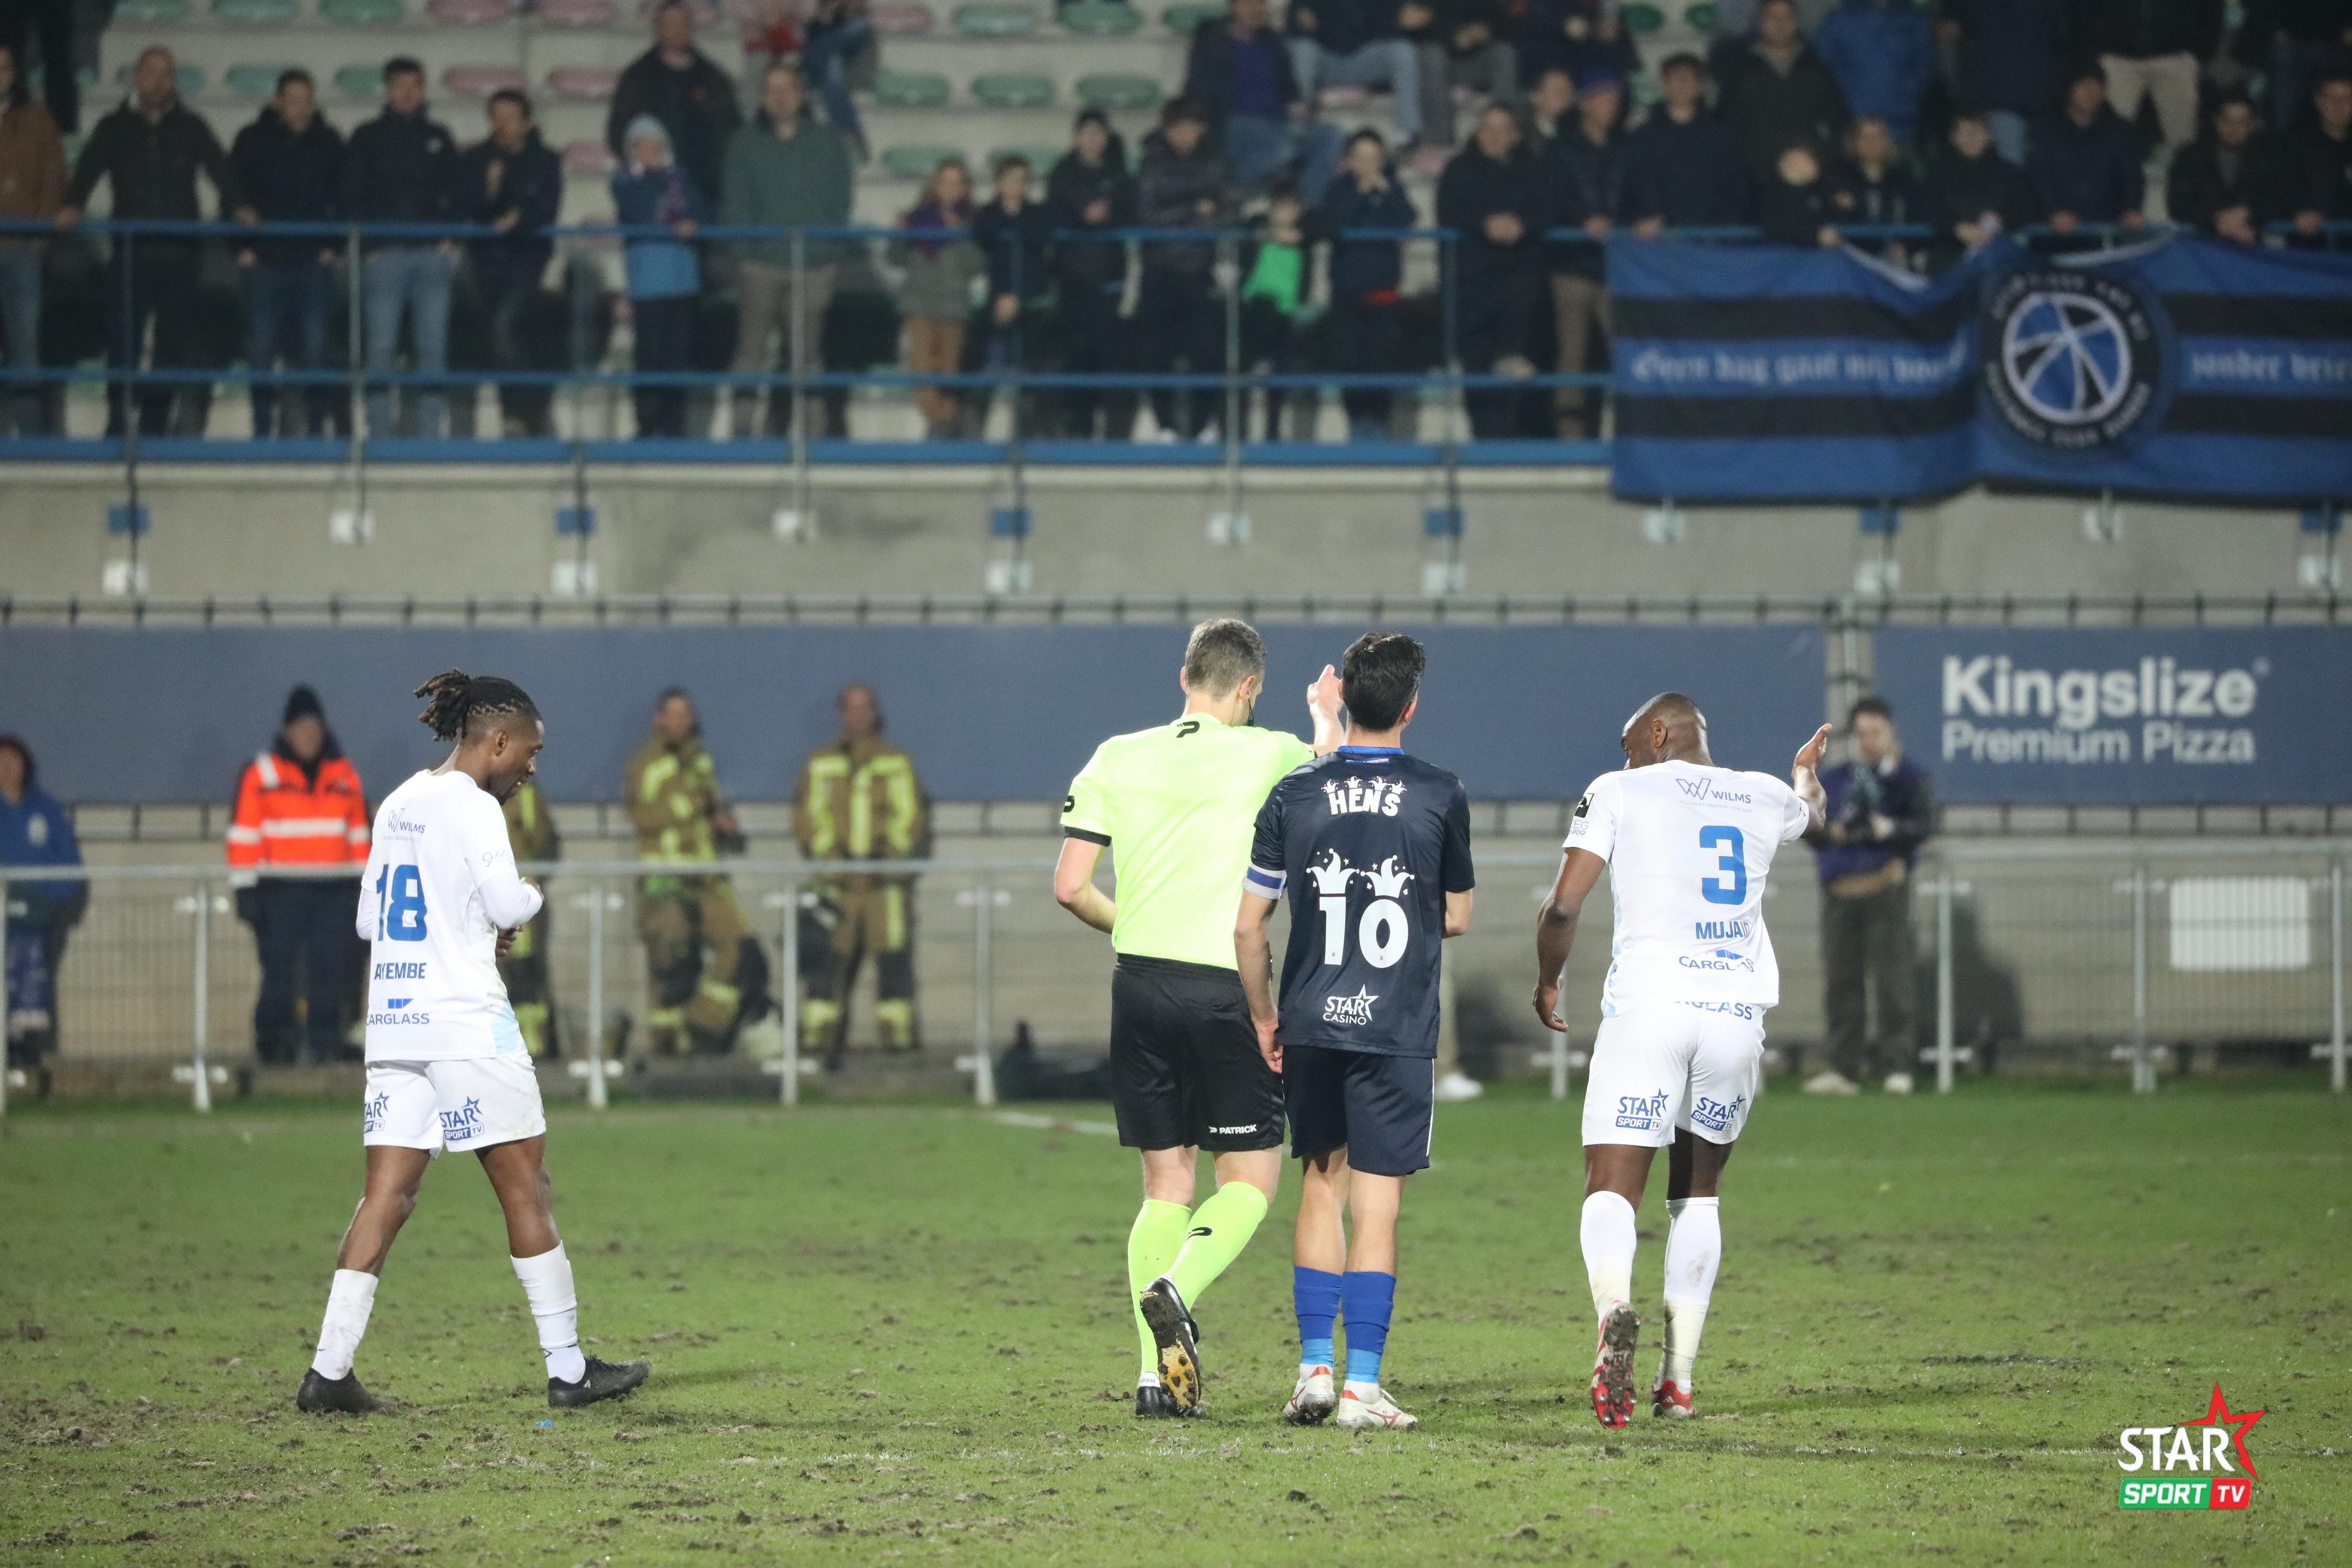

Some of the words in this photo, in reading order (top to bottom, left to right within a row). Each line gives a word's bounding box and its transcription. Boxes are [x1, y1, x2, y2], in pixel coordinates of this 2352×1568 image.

[1943, 655, 2257, 729] Kingslize
[1943, 719, 2131, 764] Premium
[2143, 719, 2255, 764] Pizza
[1328, 788, 1401, 817] HENS
[1711, 790, 1752, 804] WILMS
[399, 821, 426, 834] WILMS
[1699, 825, 1747, 905] 3
[376, 864, 428, 942] 18
[1319, 896, 1409, 968] 10
[374, 962, 428, 980] AYEMBE
[1324, 995, 1365, 1016] STAR
[1322, 1012, 1367, 1025] CASINO
[364, 1101, 383, 1120] AR
[439, 1107, 480, 1128] STAR
[1617, 1096, 1662, 1118] STAR
[1696, 1096, 1737, 1120] STAR
[1219, 1124, 1257, 1135] PATRICK
[1617, 1118, 1649, 1128] SPORT
[1692, 1112, 1724, 1131] SPORT
[445, 1128, 469, 1140] SPORT
[472, 1125, 482, 1134] TV
